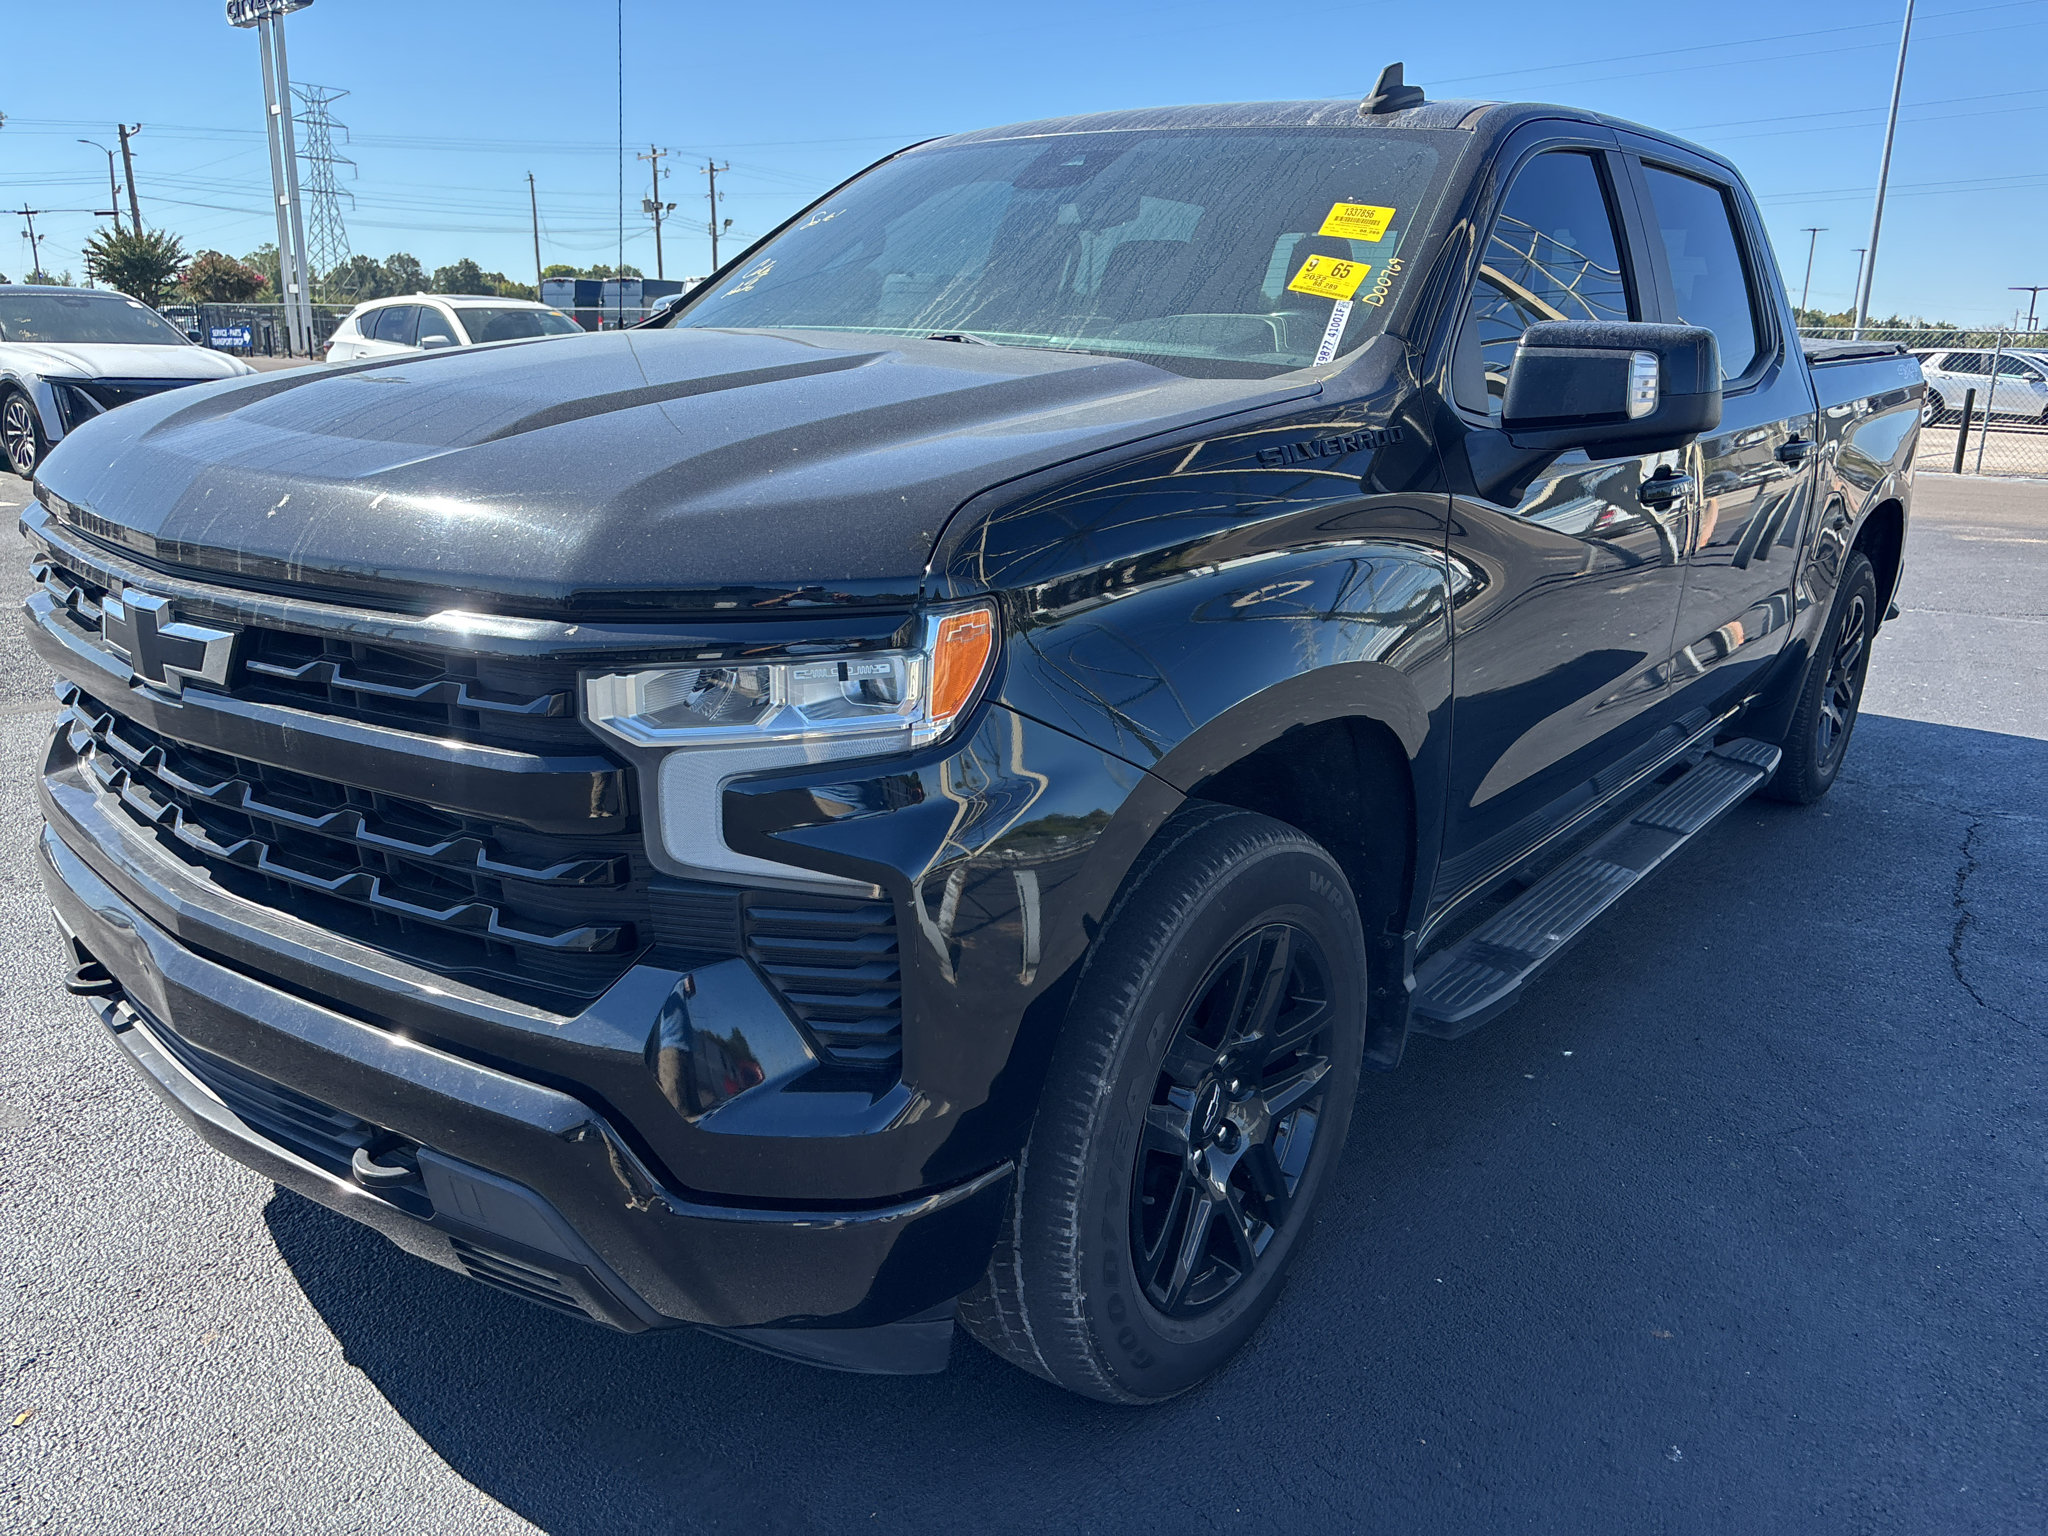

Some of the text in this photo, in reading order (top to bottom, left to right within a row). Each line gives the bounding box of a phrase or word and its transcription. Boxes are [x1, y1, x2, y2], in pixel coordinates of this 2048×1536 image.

[1344, 207, 1376, 218] 1337856
[1331, 263, 1354, 279] 65
[212, 329, 227, 337] SERVICE
[1256, 426, 1404, 468] SILVERADO
[1102, 1010, 1167, 1370] GOODYEAR
